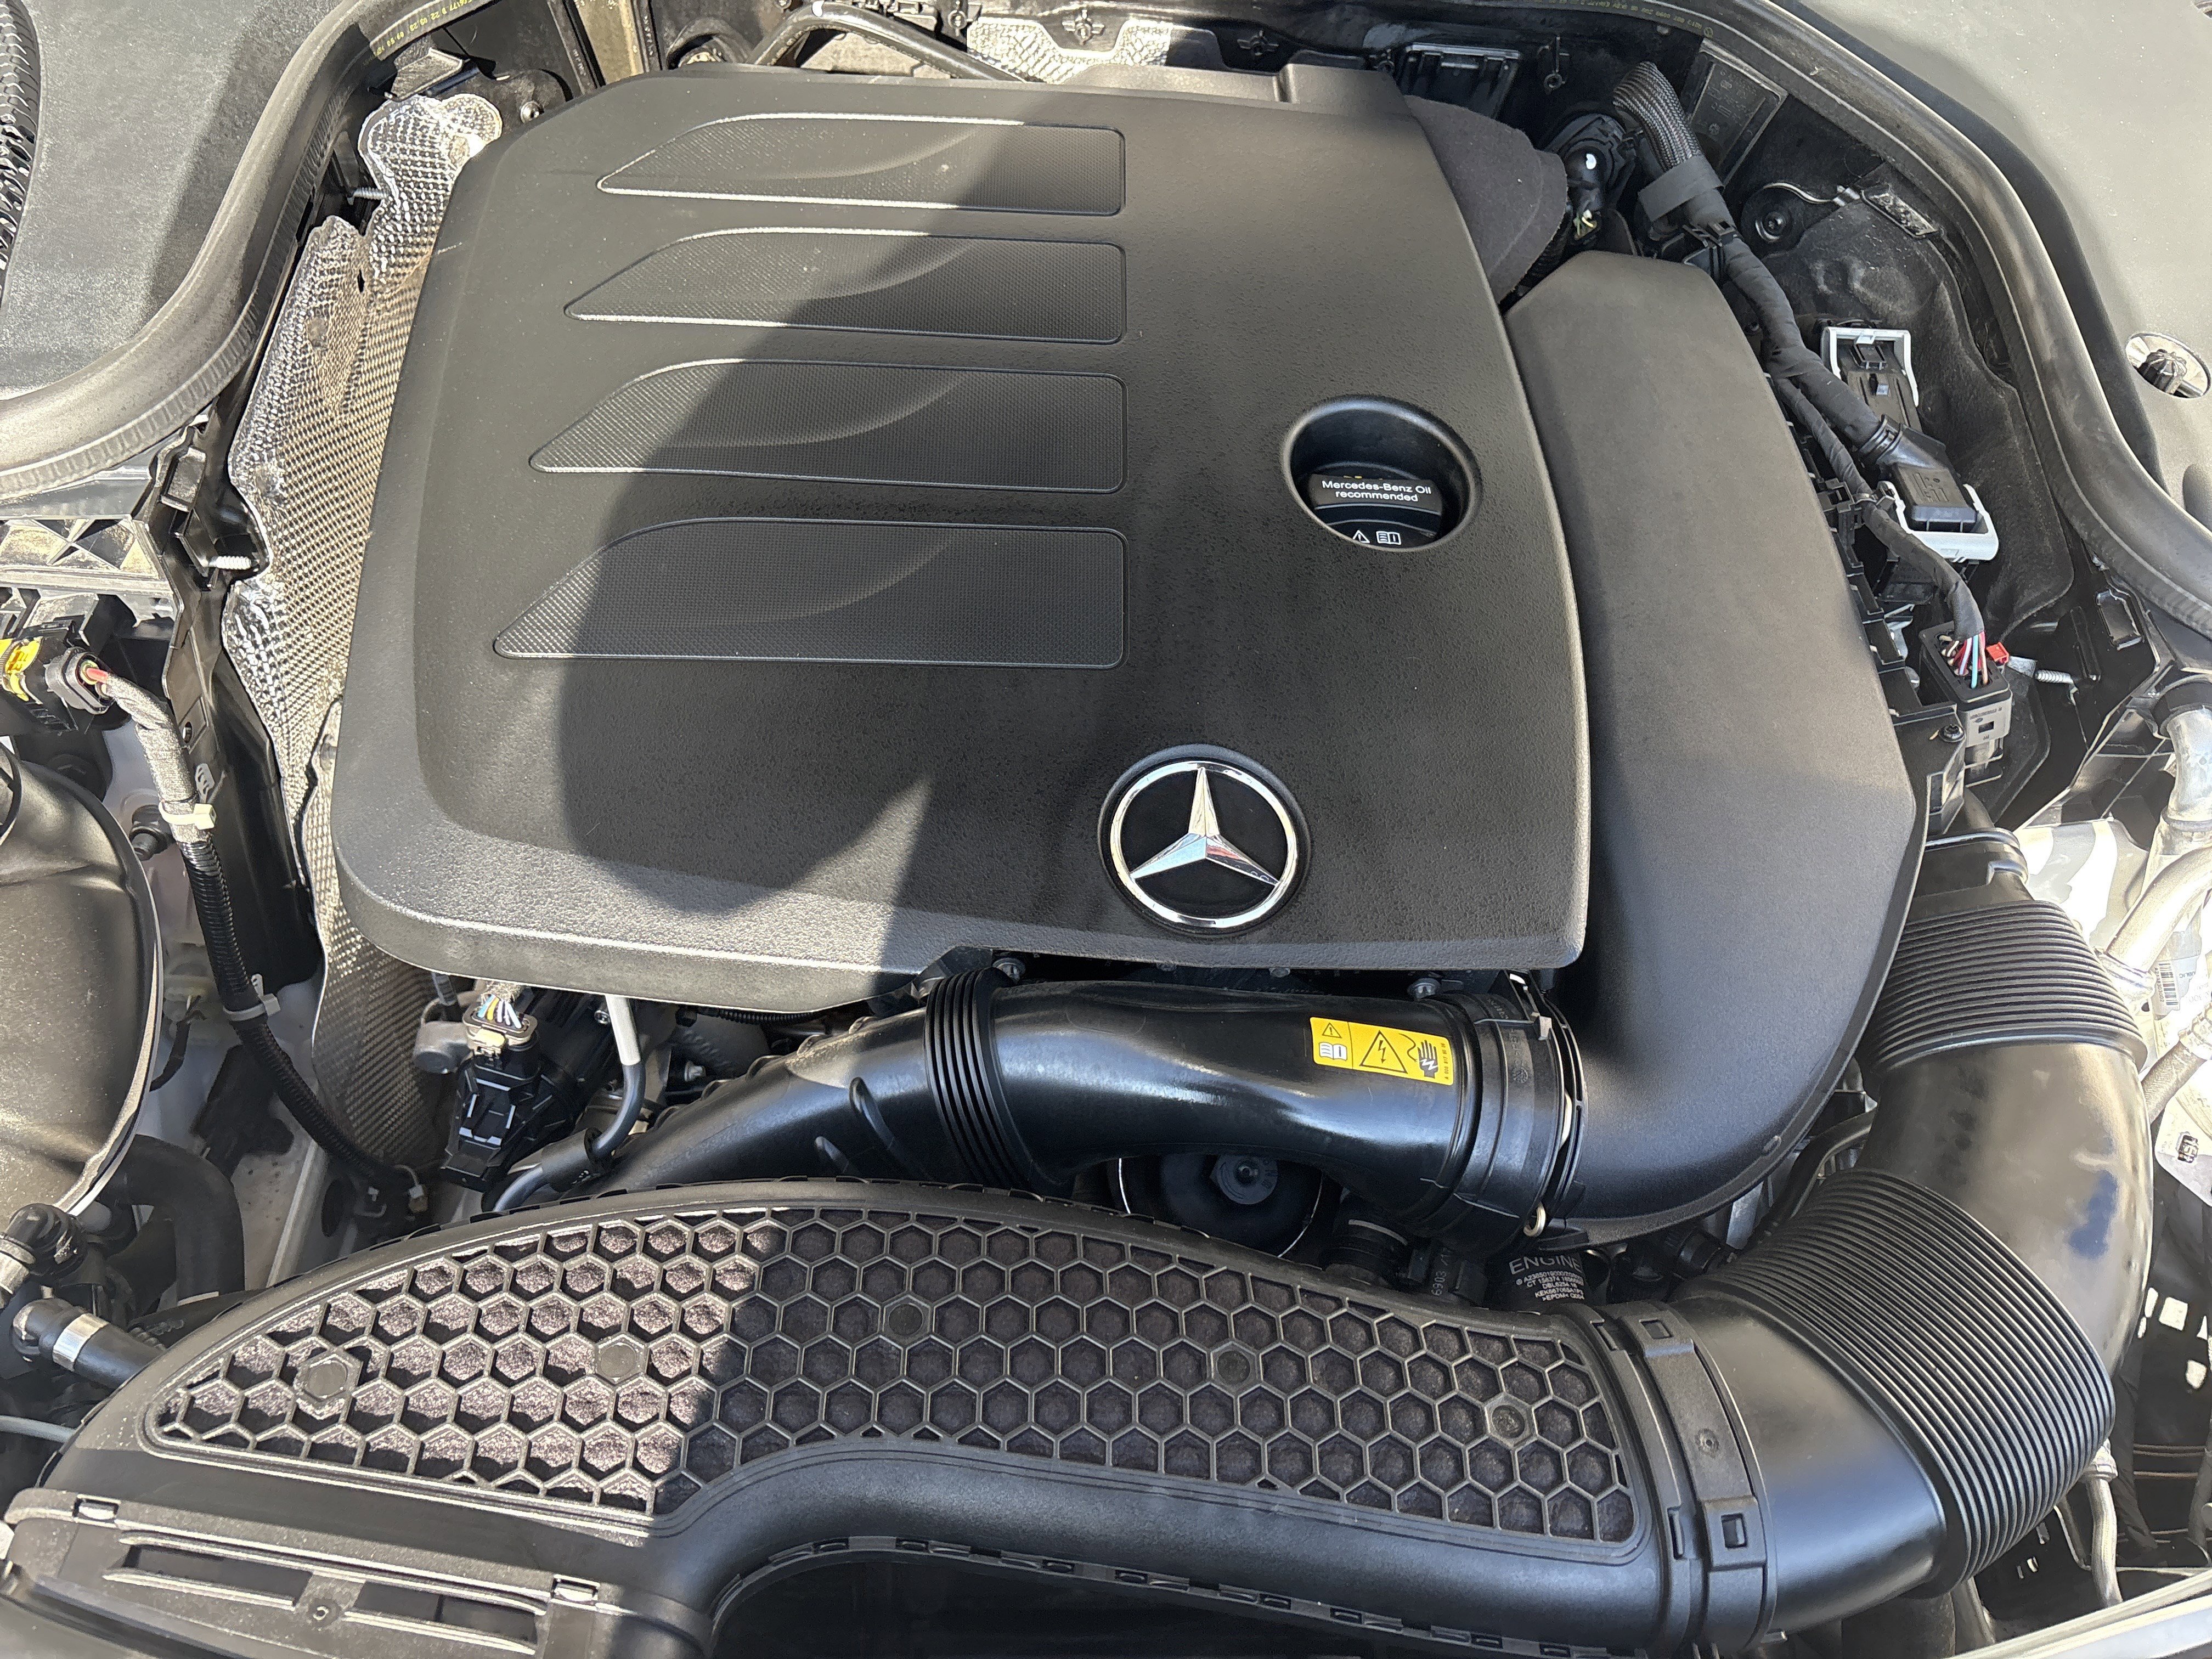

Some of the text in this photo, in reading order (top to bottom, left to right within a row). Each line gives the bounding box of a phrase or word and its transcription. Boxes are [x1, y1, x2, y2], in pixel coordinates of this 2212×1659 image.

[1322, 481, 1432, 494] Mercedes-Benz Oil
[1335, 491, 1419, 502] recommended
[1509, 1255, 1583, 1274] ENGINE
